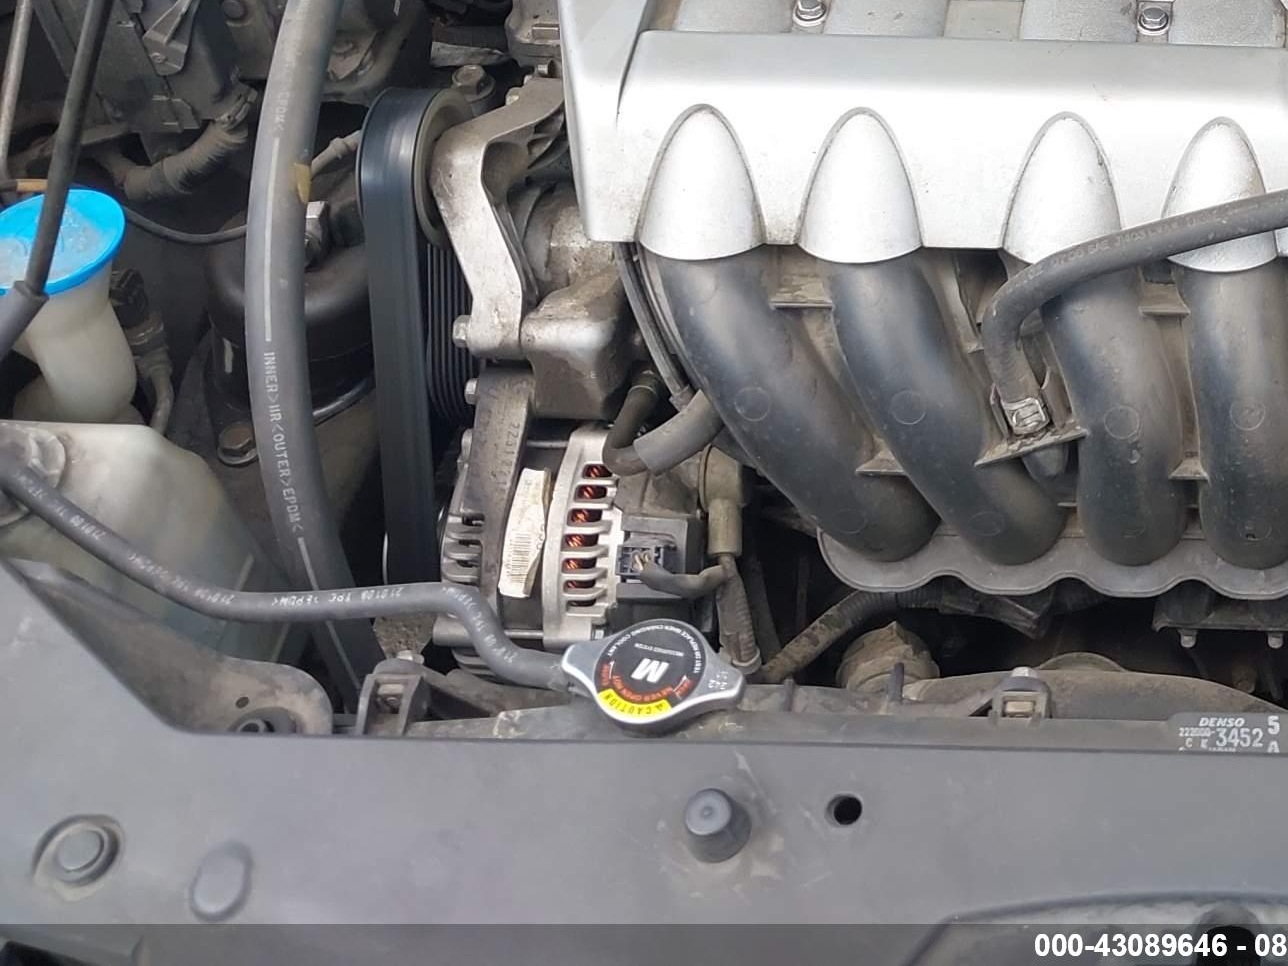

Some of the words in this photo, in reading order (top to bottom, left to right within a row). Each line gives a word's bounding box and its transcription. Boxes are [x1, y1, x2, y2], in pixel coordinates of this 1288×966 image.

[607, 633, 632, 656] COOLANT
[630, 657, 670, 684] M
[604, 692, 652, 715] CAUTION
[1199, 717, 1245, 728] DENSO
[1267, 715, 1280, 735] 5
[1215, 727, 1263, 747] 3452
[1267, 740, 1280, 753] A
